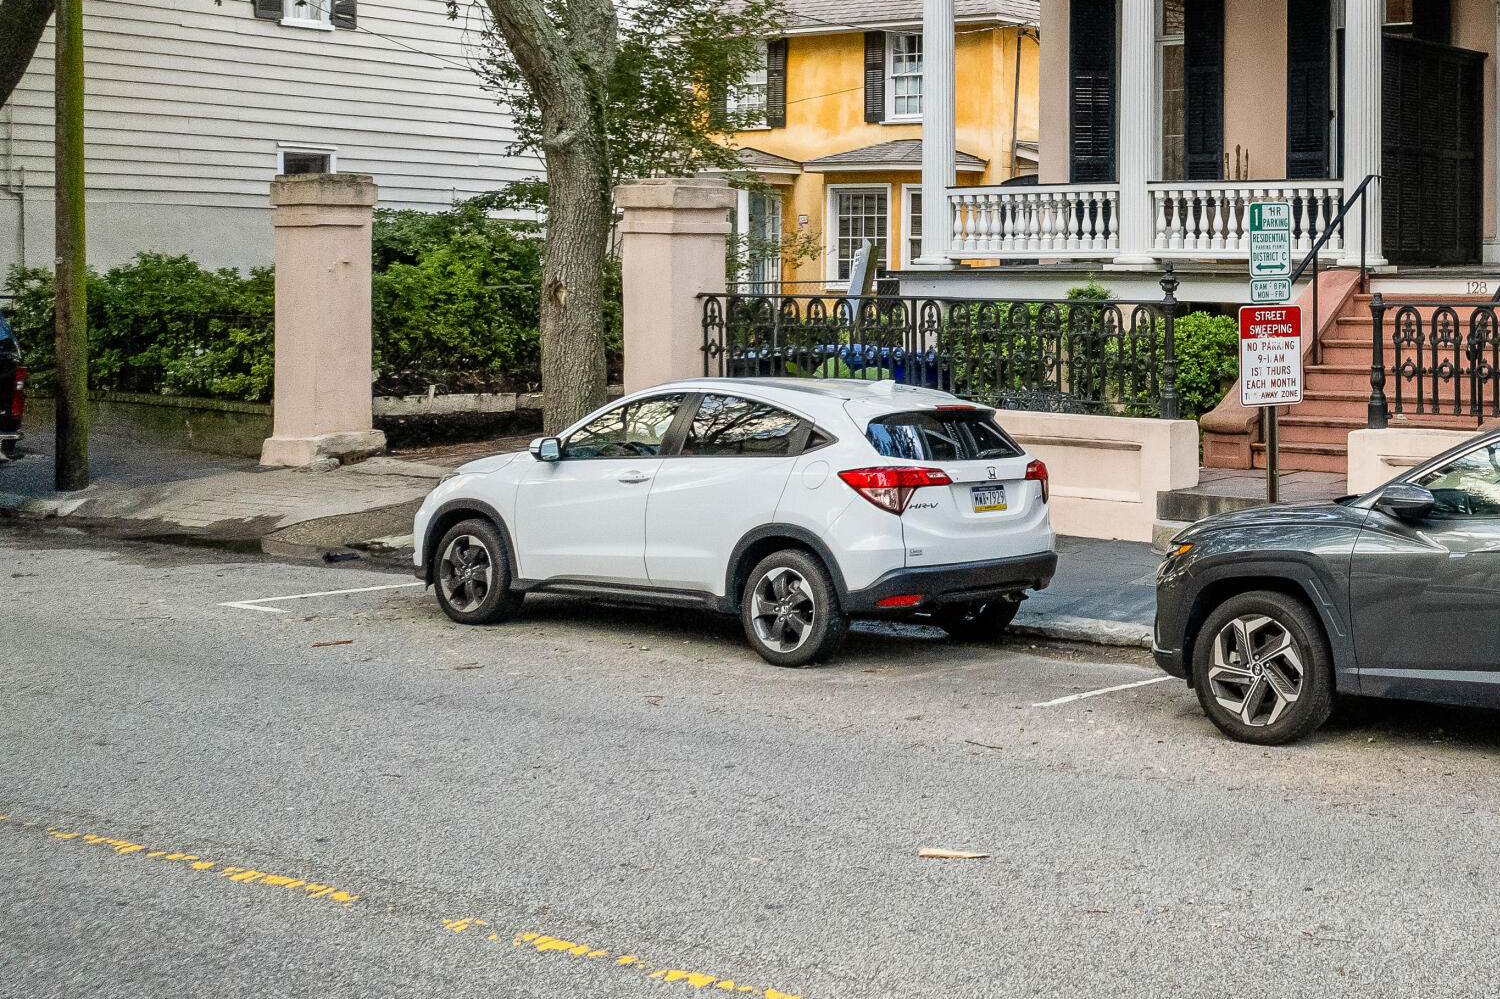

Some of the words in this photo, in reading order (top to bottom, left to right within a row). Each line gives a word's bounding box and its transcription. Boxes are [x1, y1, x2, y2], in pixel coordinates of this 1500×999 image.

[1270, 207, 1281, 216] HR
[1254, 208, 1259, 227] 1
[1263, 218, 1288, 228] PARKING
[1252, 233, 1288, 243] RESIDENTIAL
[1253, 252, 1279, 262] DISTRICT
[1281, 252, 1287, 261] C
[1467, 281, 1488, 294] 128
[1257, 291, 1270, 299] MON
[1275, 290, 1285, 298] FRI
[1254, 310, 1287, 321] STREET
[1249, 324, 1292, 335] SWEEPING
[1247, 342, 1258, 352] NO
[1273, 353, 1285, 363] AM
[1266, 365, 1291, 375] THURS
[1246, 380, 1266, 389] EACH
[1270, 378, 1297, 389] MONTH
[1281, 389, 1299, 398] ZONE
